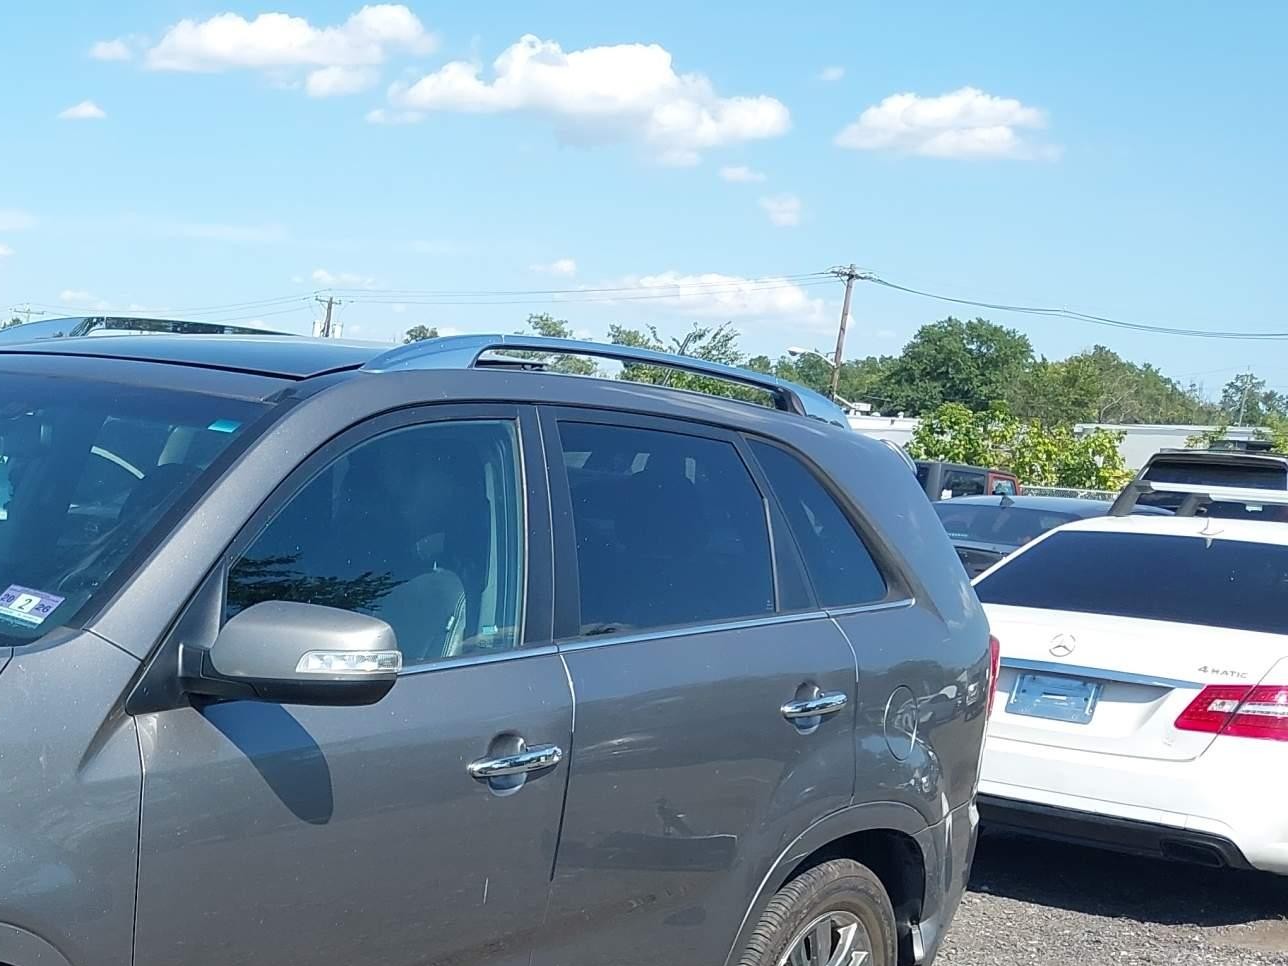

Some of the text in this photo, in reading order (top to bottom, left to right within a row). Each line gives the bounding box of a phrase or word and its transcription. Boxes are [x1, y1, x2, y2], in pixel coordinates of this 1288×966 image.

[0, 593, 15, 603] 20
[18, 598, 33, 610] 2
[35, 604, 52, 614] 26
